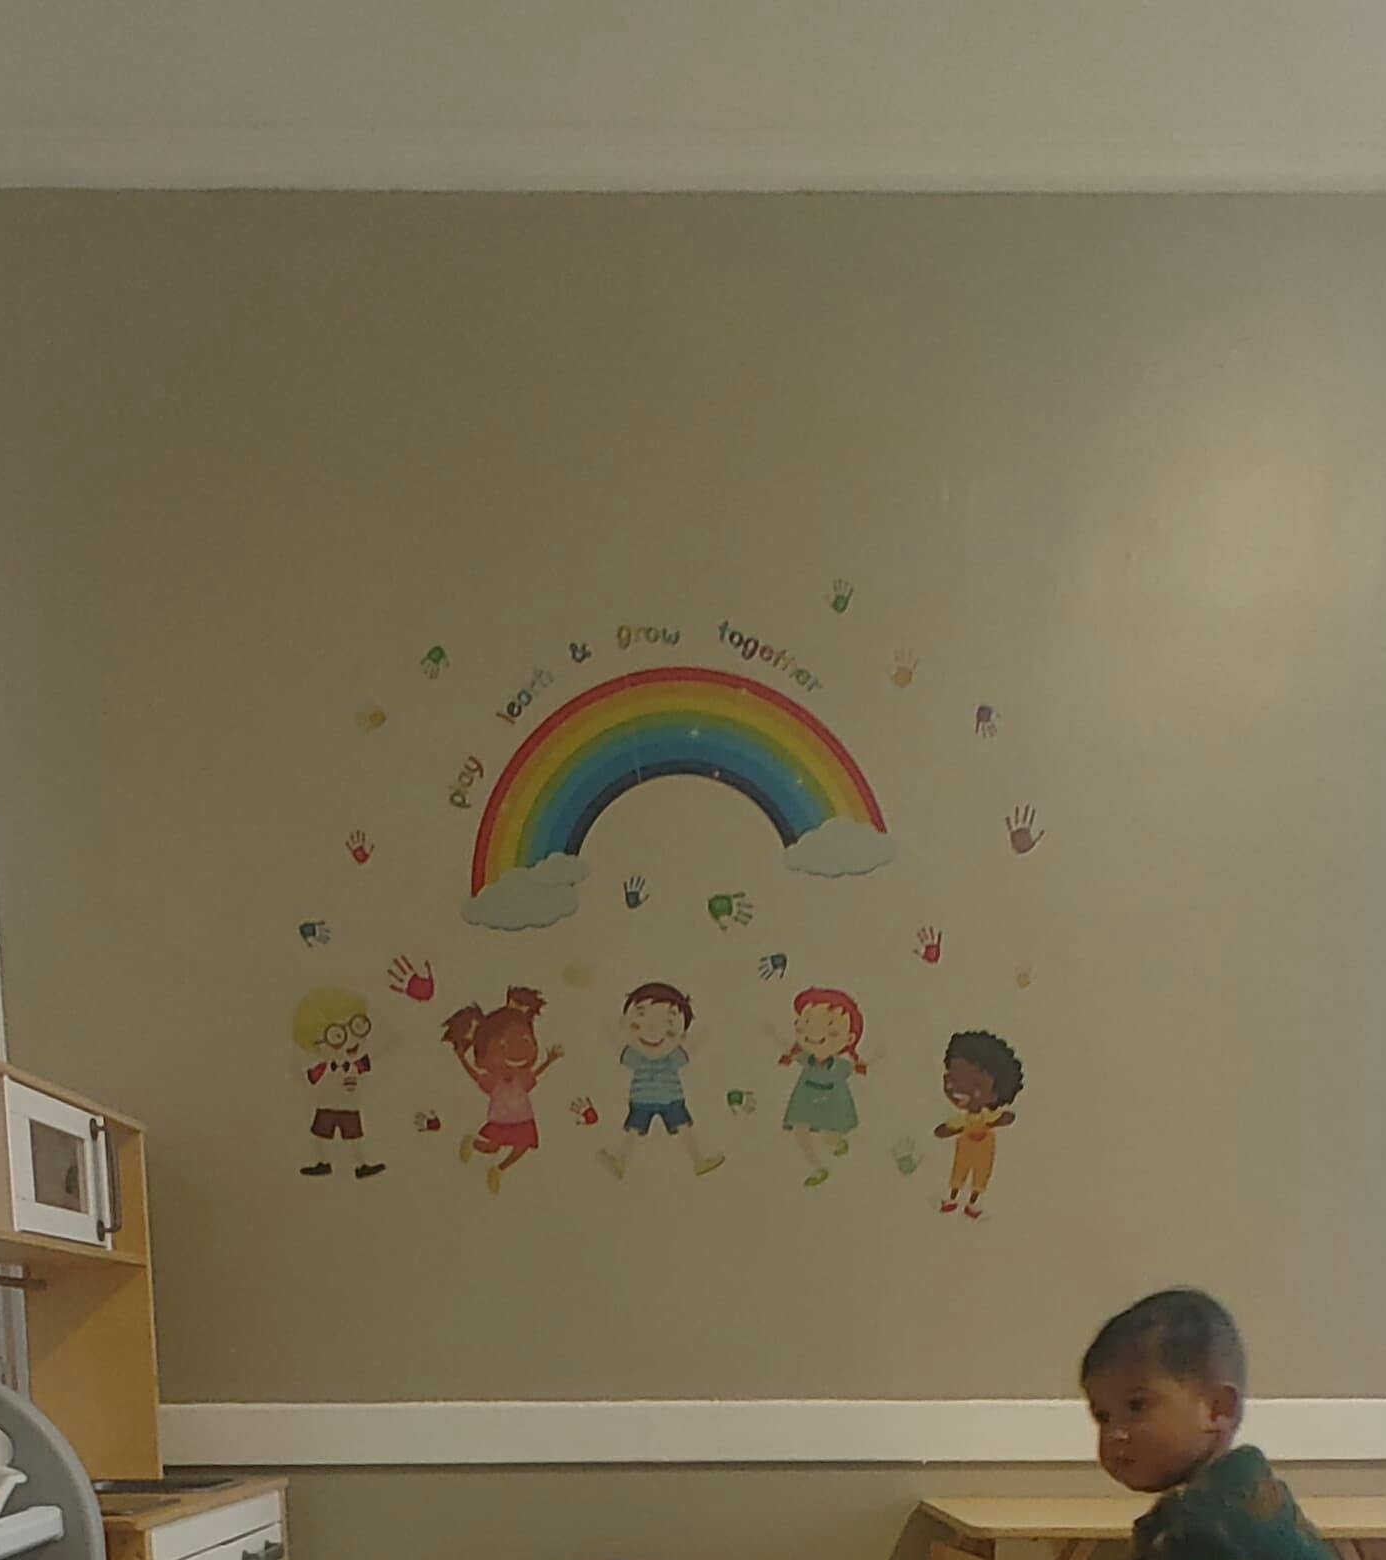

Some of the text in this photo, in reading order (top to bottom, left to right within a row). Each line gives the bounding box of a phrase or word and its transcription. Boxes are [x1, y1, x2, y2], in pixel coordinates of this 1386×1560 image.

[495, 669, 554, 725] learn
[568, 641, 591, 663] &
[616, 624, 680, 650] grow
[718, 619, 823, 693] together
